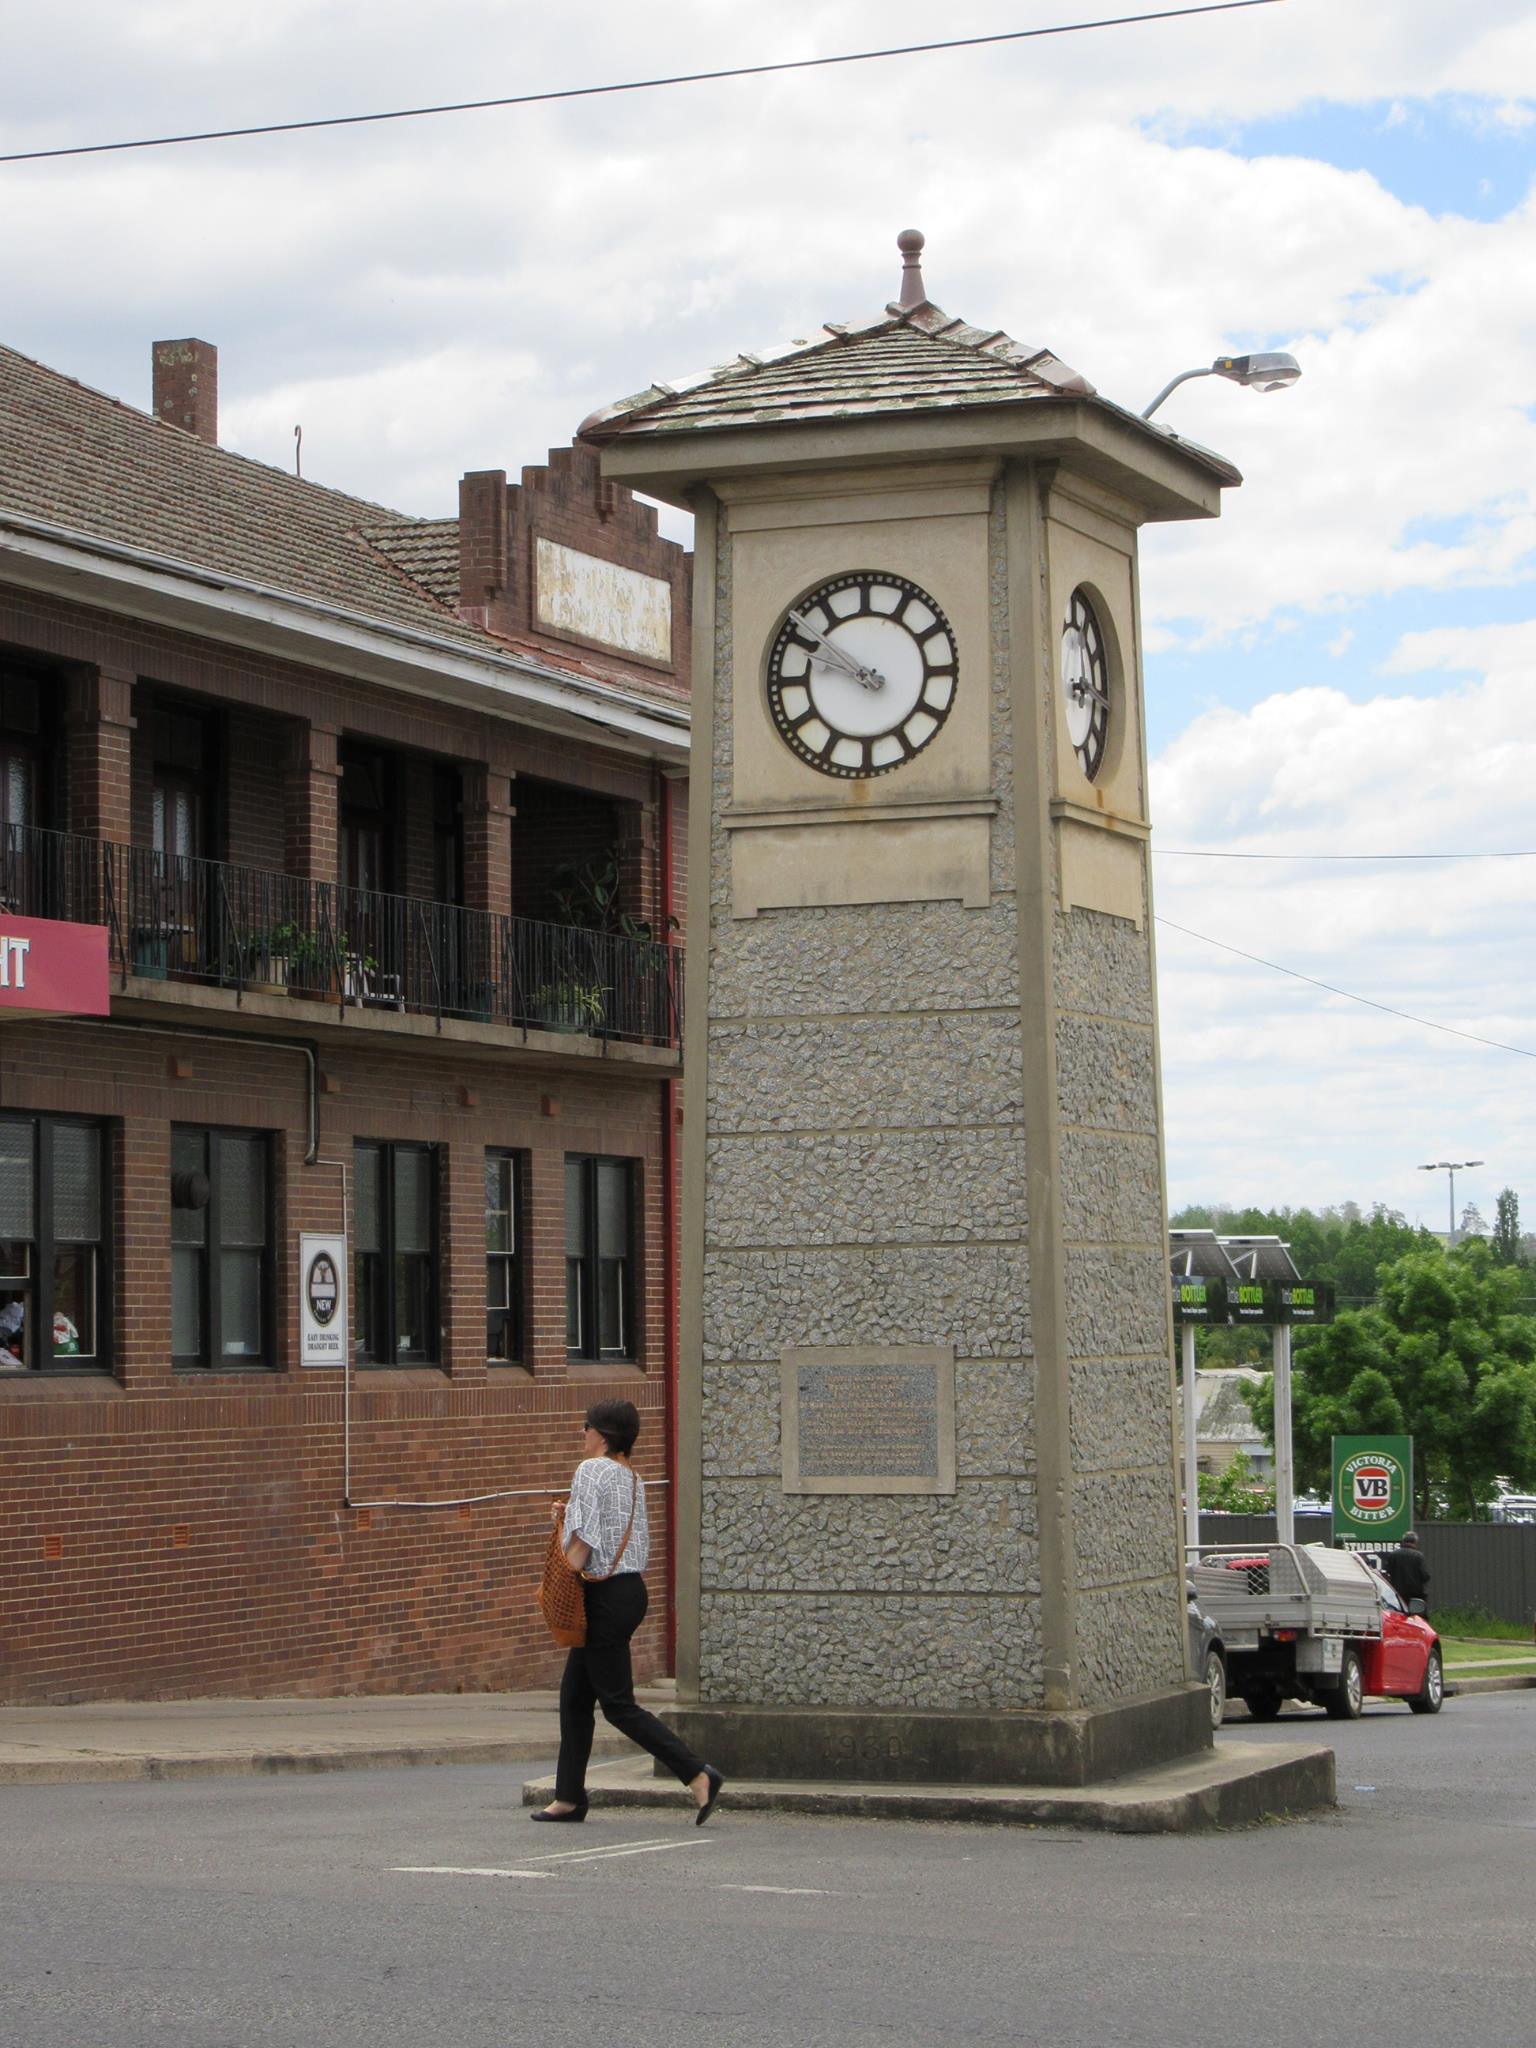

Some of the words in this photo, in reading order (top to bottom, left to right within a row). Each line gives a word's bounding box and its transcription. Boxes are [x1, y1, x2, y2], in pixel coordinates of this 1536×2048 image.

[316, 1299, 332, 1310] NEW
[1345, 1455, 1398, 1475] VICTORIA
[1356, 1478, 1388, 1497] VB
[1350, 1506, 1395, 1520] BITTER
[1344, 1542, 1401, 1552] STUBBIES
